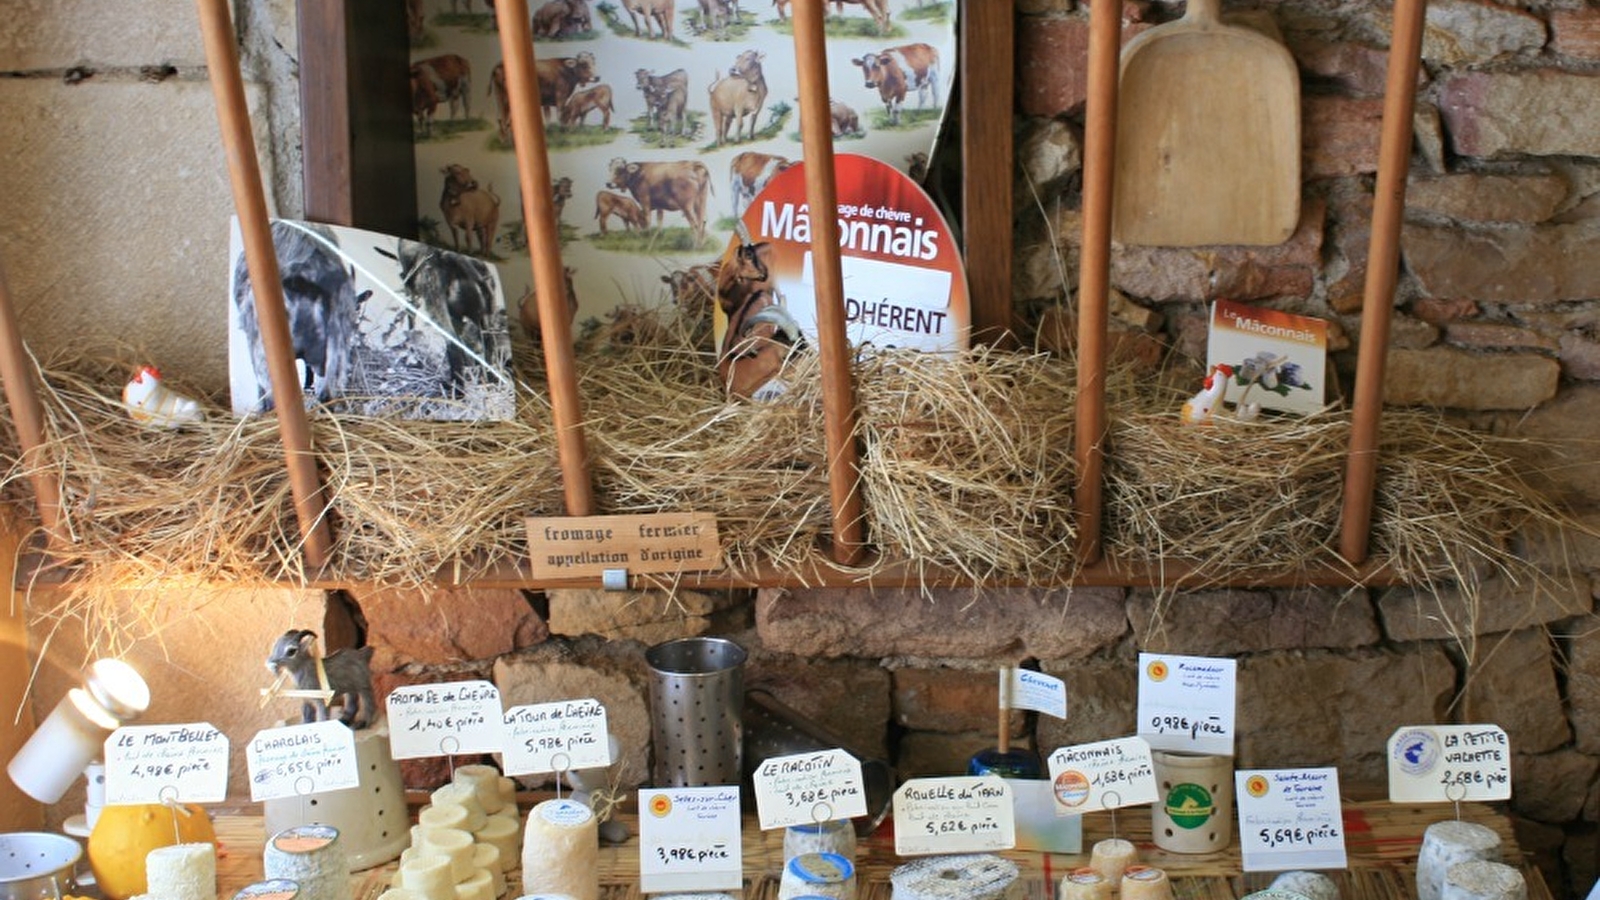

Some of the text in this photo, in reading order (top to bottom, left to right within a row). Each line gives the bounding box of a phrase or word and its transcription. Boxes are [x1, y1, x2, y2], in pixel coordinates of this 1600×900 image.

[859, 204, 875, 217] de
[875, 208, 912, 223] chèvre
[760, 200, 939, 261] Mâonnais
[845, 297, 947, 334] DHÉRENT
[1223, 308, 1317, 342] Le Mâconnais
[544, 523, 700, 543] fromage fermier
[547, 550, 629, 567] appellation
[117, 734, 134, 748] LE
[1444, 735, 1459, 748] LA
[1463, 731, 1506, 746] PETITE
[762, 763, 778, 777] LE
